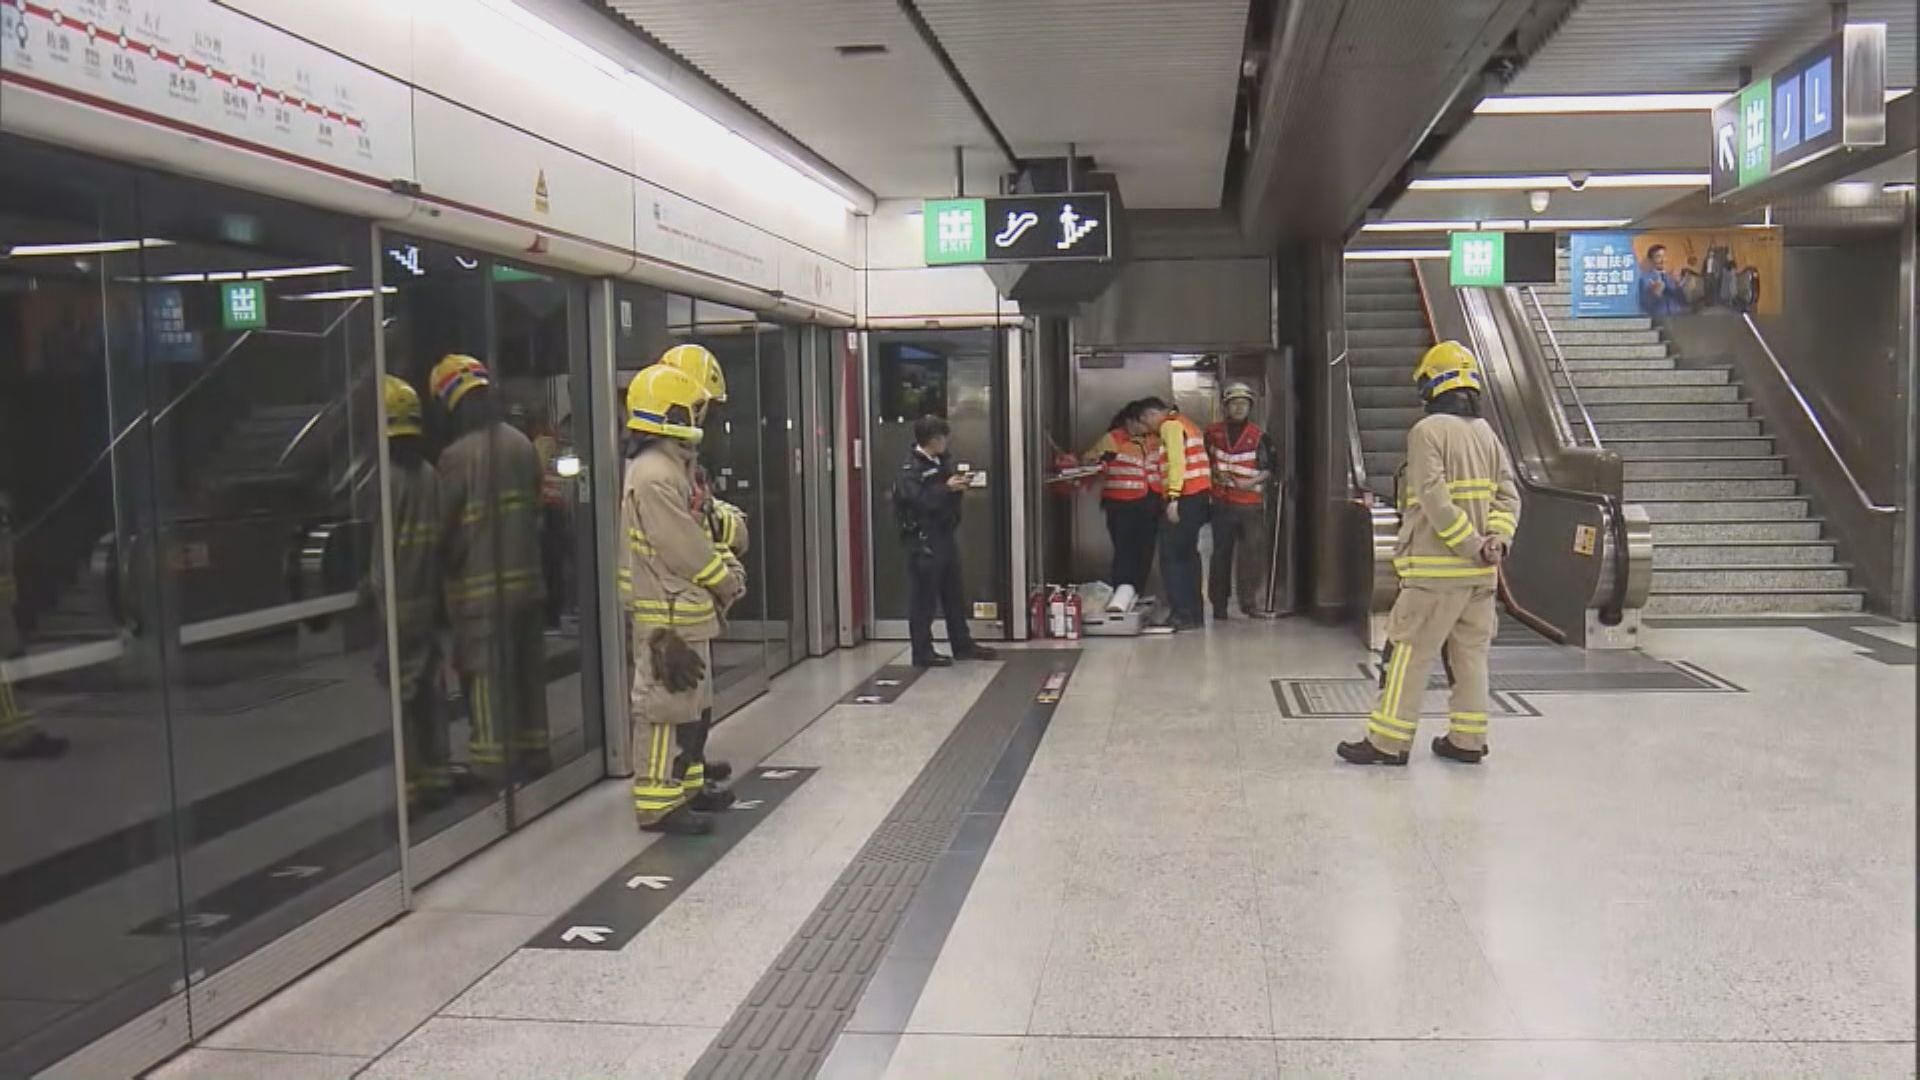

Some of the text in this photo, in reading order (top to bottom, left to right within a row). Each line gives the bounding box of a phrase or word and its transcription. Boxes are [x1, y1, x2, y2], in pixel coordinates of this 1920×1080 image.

[113, 53, 134, 74] 旺角
[1783, 77, 1826, 140] J L
[1747, 98, 1764, 148] 出
[939, 209, 972, 239] 出
[939, 240, 973, 253] EXIT
[1463, 240, 1492, 266] 出
[1463, 265, 1491, 277] EXIT
